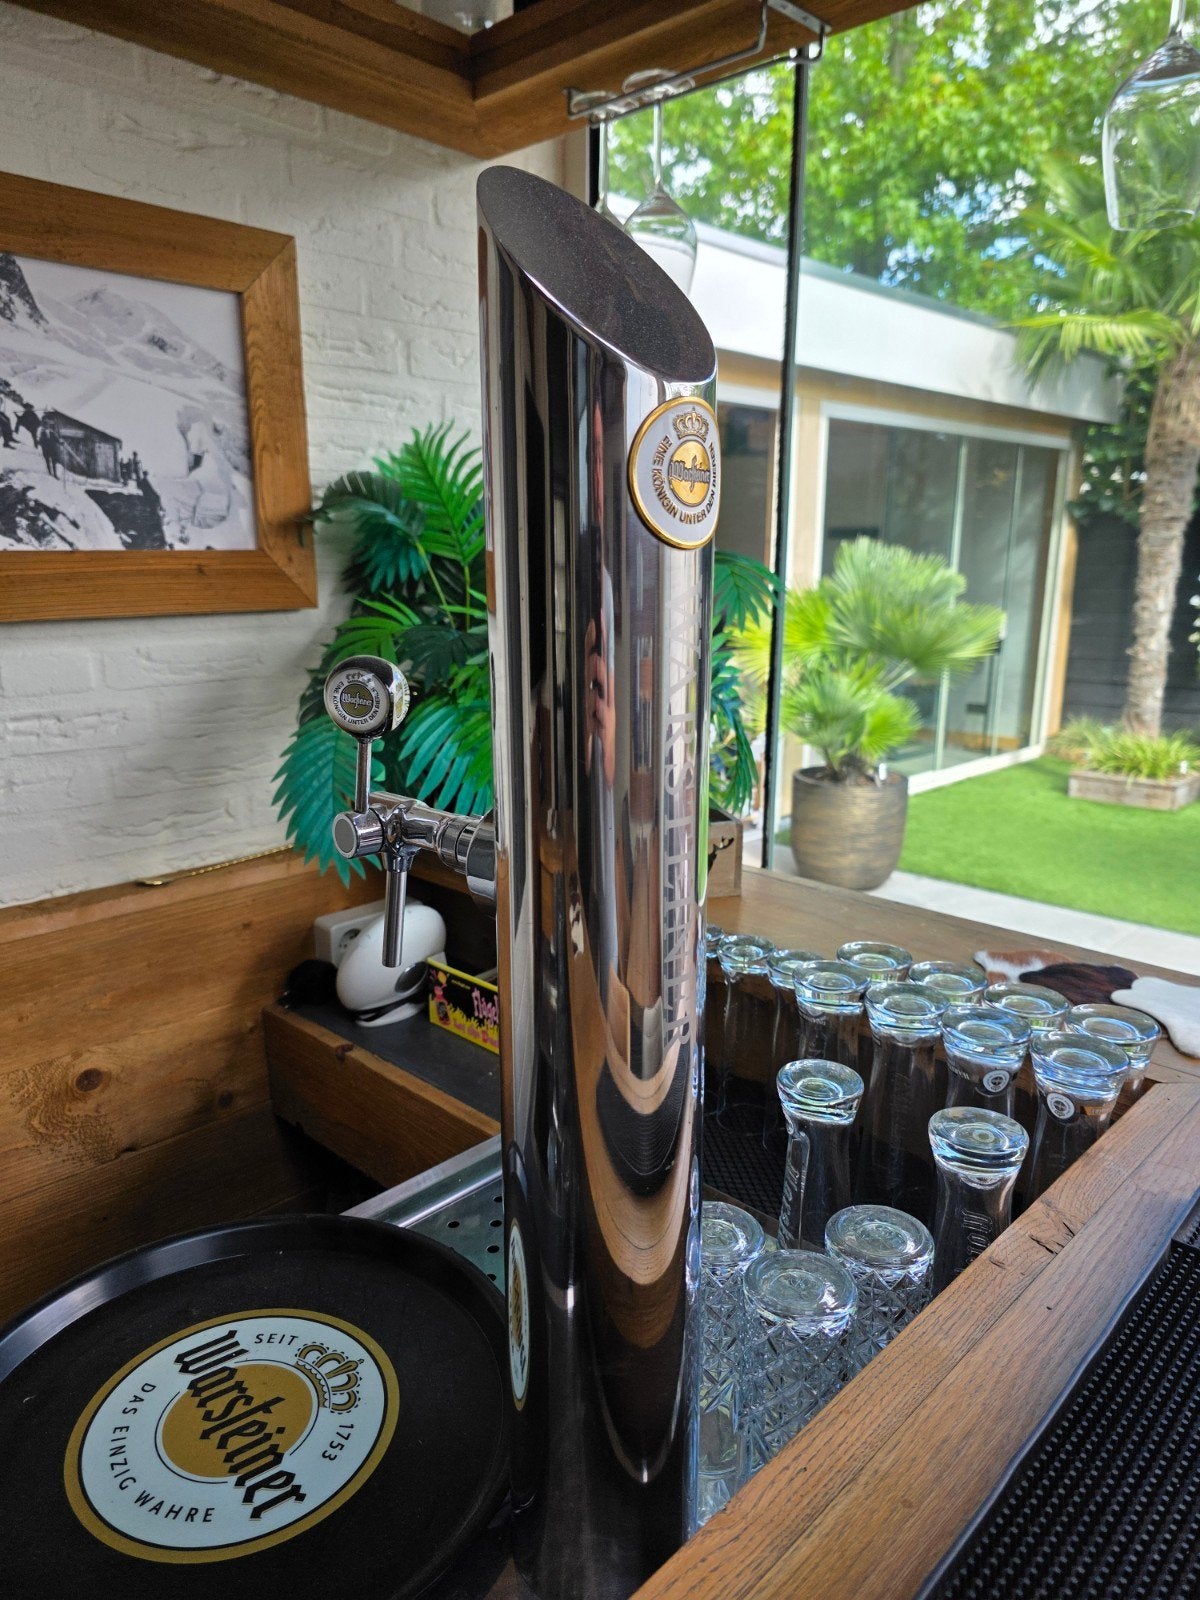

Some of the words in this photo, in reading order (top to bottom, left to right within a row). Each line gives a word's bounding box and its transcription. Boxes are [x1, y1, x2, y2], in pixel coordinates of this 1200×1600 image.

[652, 435, 672, 466] EINE
[652, 468, 679, 519] KÖNIGIN
[705, 490, 715, 514] DEN
[679, 510, 707, 525] UNTER
[347, 718, 369, 726] UNTER
[369, 709, 380, 721] DEN
[662, 575, 703, 1058] WARSTEINER
[121, 1382, 157, 1416] DAS
[254, 1333, 299, 1347] SEIT
[321, 1421, 355, 1463] 1753
[173, 1330, 307, 1520] Warsteiner
[108, 1425, 137, 1491] EINZIG
[134, 1490, 215, 1523] WAHRE
